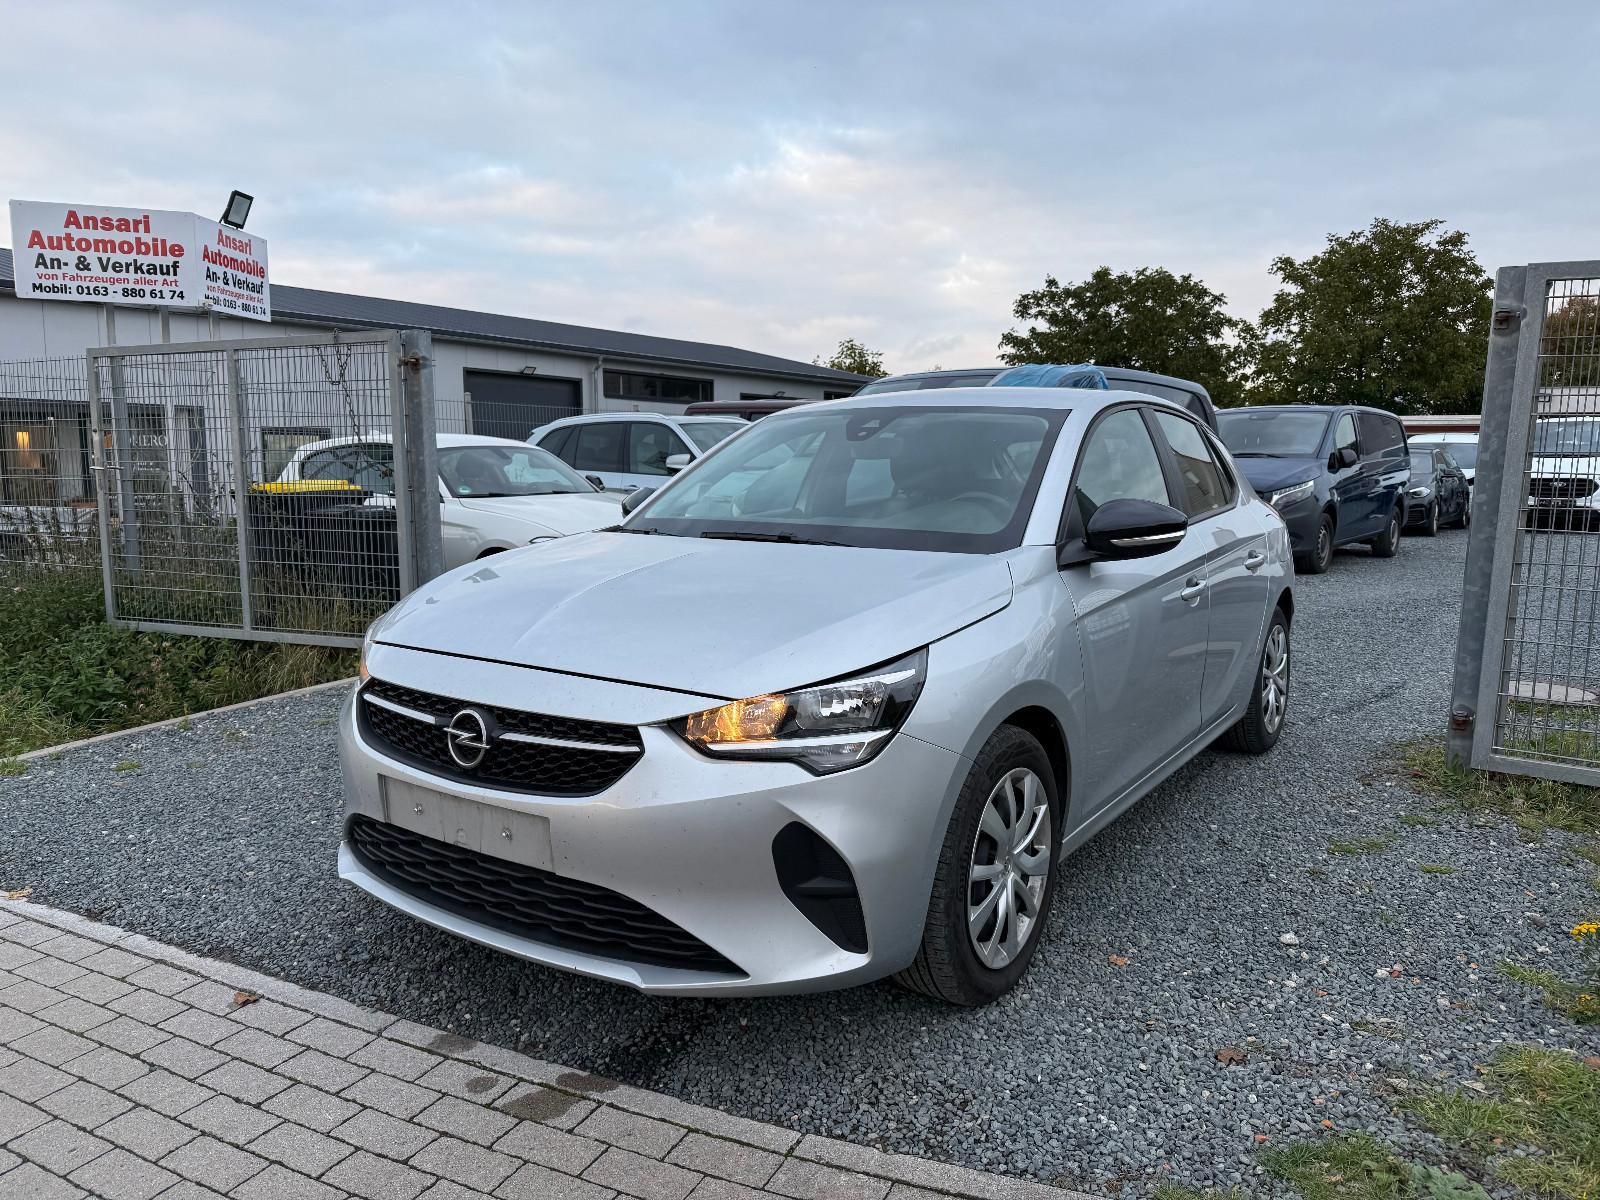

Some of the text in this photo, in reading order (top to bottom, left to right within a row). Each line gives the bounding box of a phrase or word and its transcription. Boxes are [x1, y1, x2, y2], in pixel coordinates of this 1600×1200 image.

[64, 210, 150, 233] Ansari
[28, 230, 184, 257] Automobile
[217, 228, 252, 256] Ansari
[35, 253, 179, 276] An- & Verkauf
[203, 244, 265, 279] Automobile
[32, 282, 72, 295] Mobil:
[76, 285, 108, 296] 0163
[121, 288, 146, 298] 880
[150, 289, 165, 299] 61
[169, 290, 185, 300] 74
[37, 272, 179, 287] von Fahrzeugen aller Art
[205, 266, 264, 295] An- & Verkauf
[207, 284, 216, 292] von
[217, 285, 245, 301] Fahrzeugen
[223, 298, 237, 310] 0163
[241, 302, 252, 313] 880
